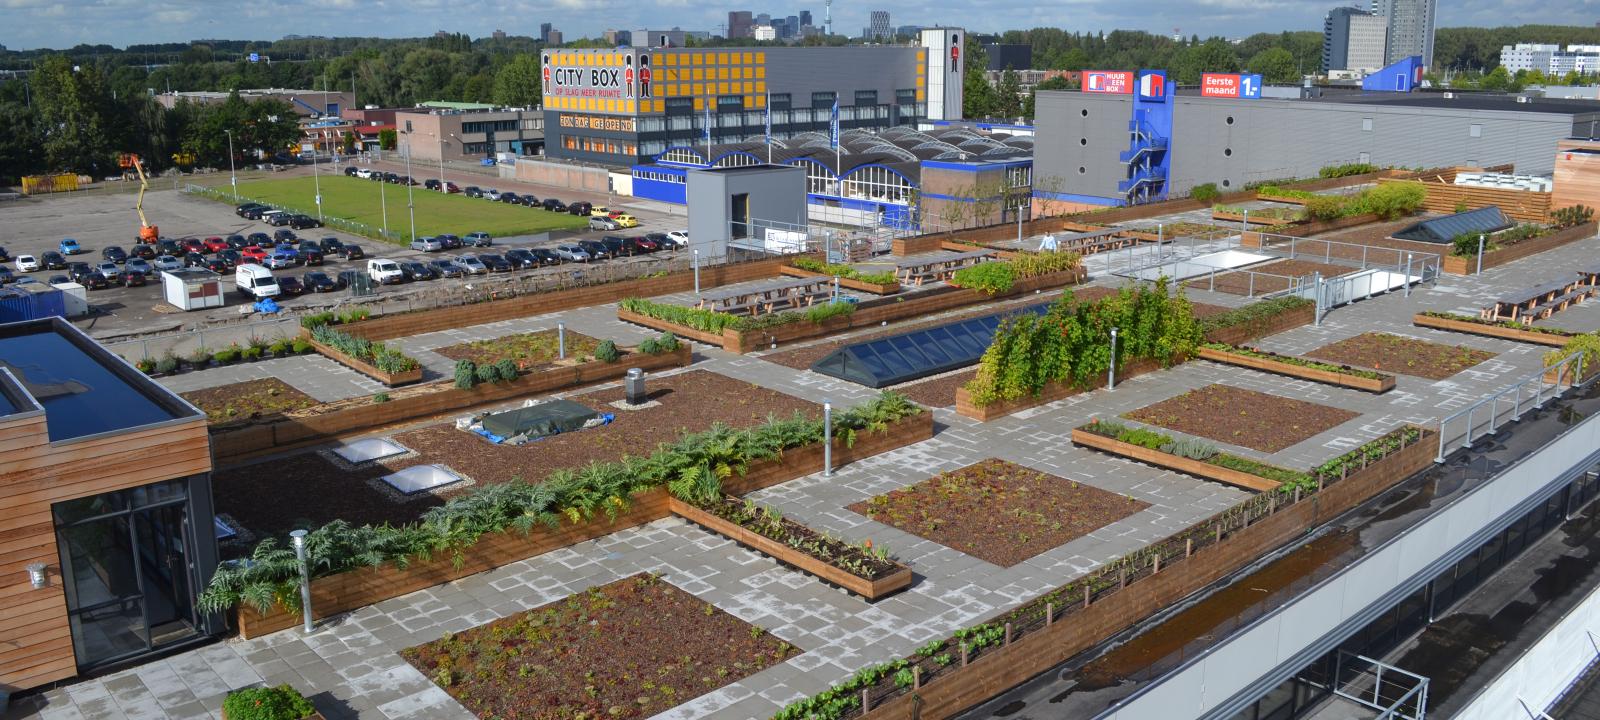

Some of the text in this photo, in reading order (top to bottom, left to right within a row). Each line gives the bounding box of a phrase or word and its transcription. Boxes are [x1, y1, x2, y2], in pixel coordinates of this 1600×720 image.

[555, 67, 619, 87] CITY BOX
[1206, 76, 1233, 85] Eerste
[565, 88, 579, 96] SLAG
[581, 89, 596, 97] MEER
[598, 89, 621, 98] RUIMTE
[1205, 86, 1236, 95] maand
